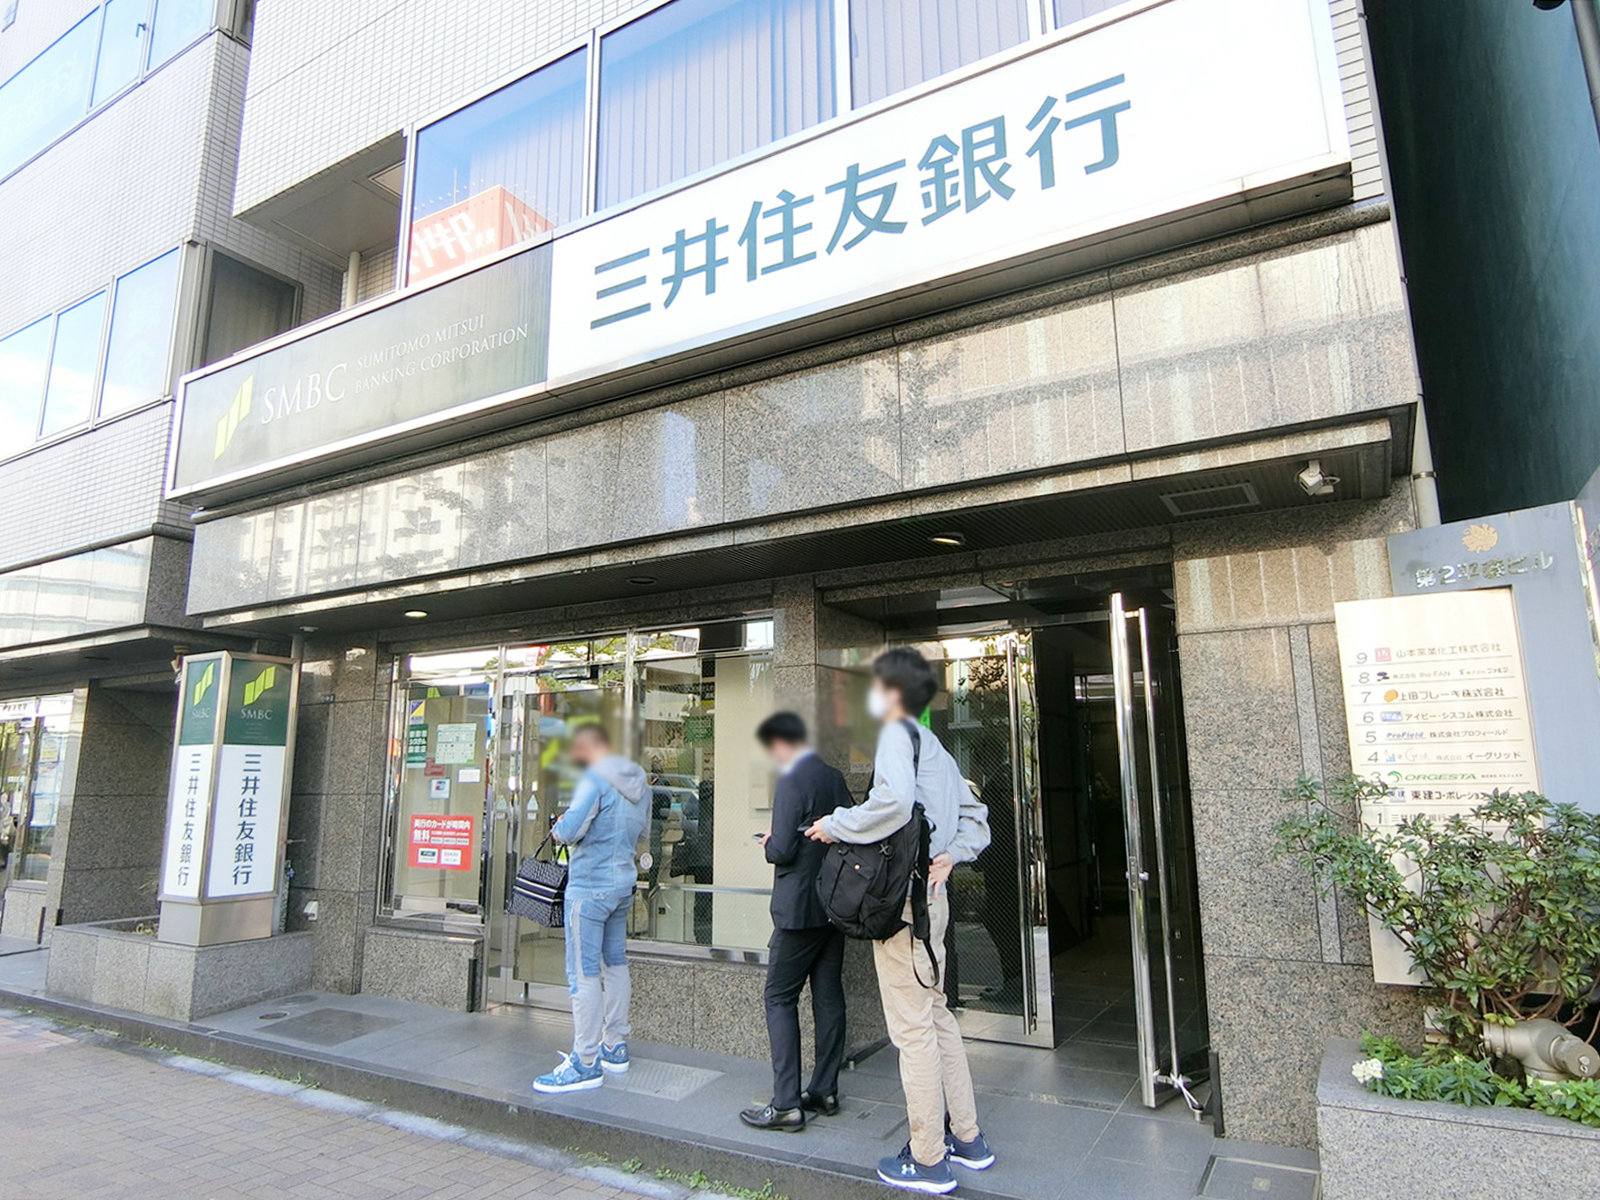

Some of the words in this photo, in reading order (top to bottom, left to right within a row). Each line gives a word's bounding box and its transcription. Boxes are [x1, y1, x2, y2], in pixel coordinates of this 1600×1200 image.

[590, 73, 1131, 329] 三井住友銀行
[356, 333, 431, 371] SUMITOMO
[434, 314, 485, 344] MITSUI
[355, 361, 416, 394] BANKING
[420, 323, 528, 373] CORPORATION
[261, 363, 347, 424] SMBC
[1356, 652, 1368, 664] 9
[1358, 672, 1370, 684] 8
[1361, 691, 1372, 703] 7
[191, 707, 212, 719] SMBC
[241, 708, 273, 720] SMBC
[1363, 711, 1374, 723] 6
[1365, 731, 1377, 743] 5
[1367, 751, 1379, 763] 4
[1466, 751, 1521, 761] イーグリッド
[1370, 771, 1381, 783] 3
[1405, 773, 1476, 781] ORGESTA
[178, 753, 201, 886] 三井住友銀行
[232, 754, 262, 885] 三井住友銀行
[1377, 812, 1382, 824] 1
